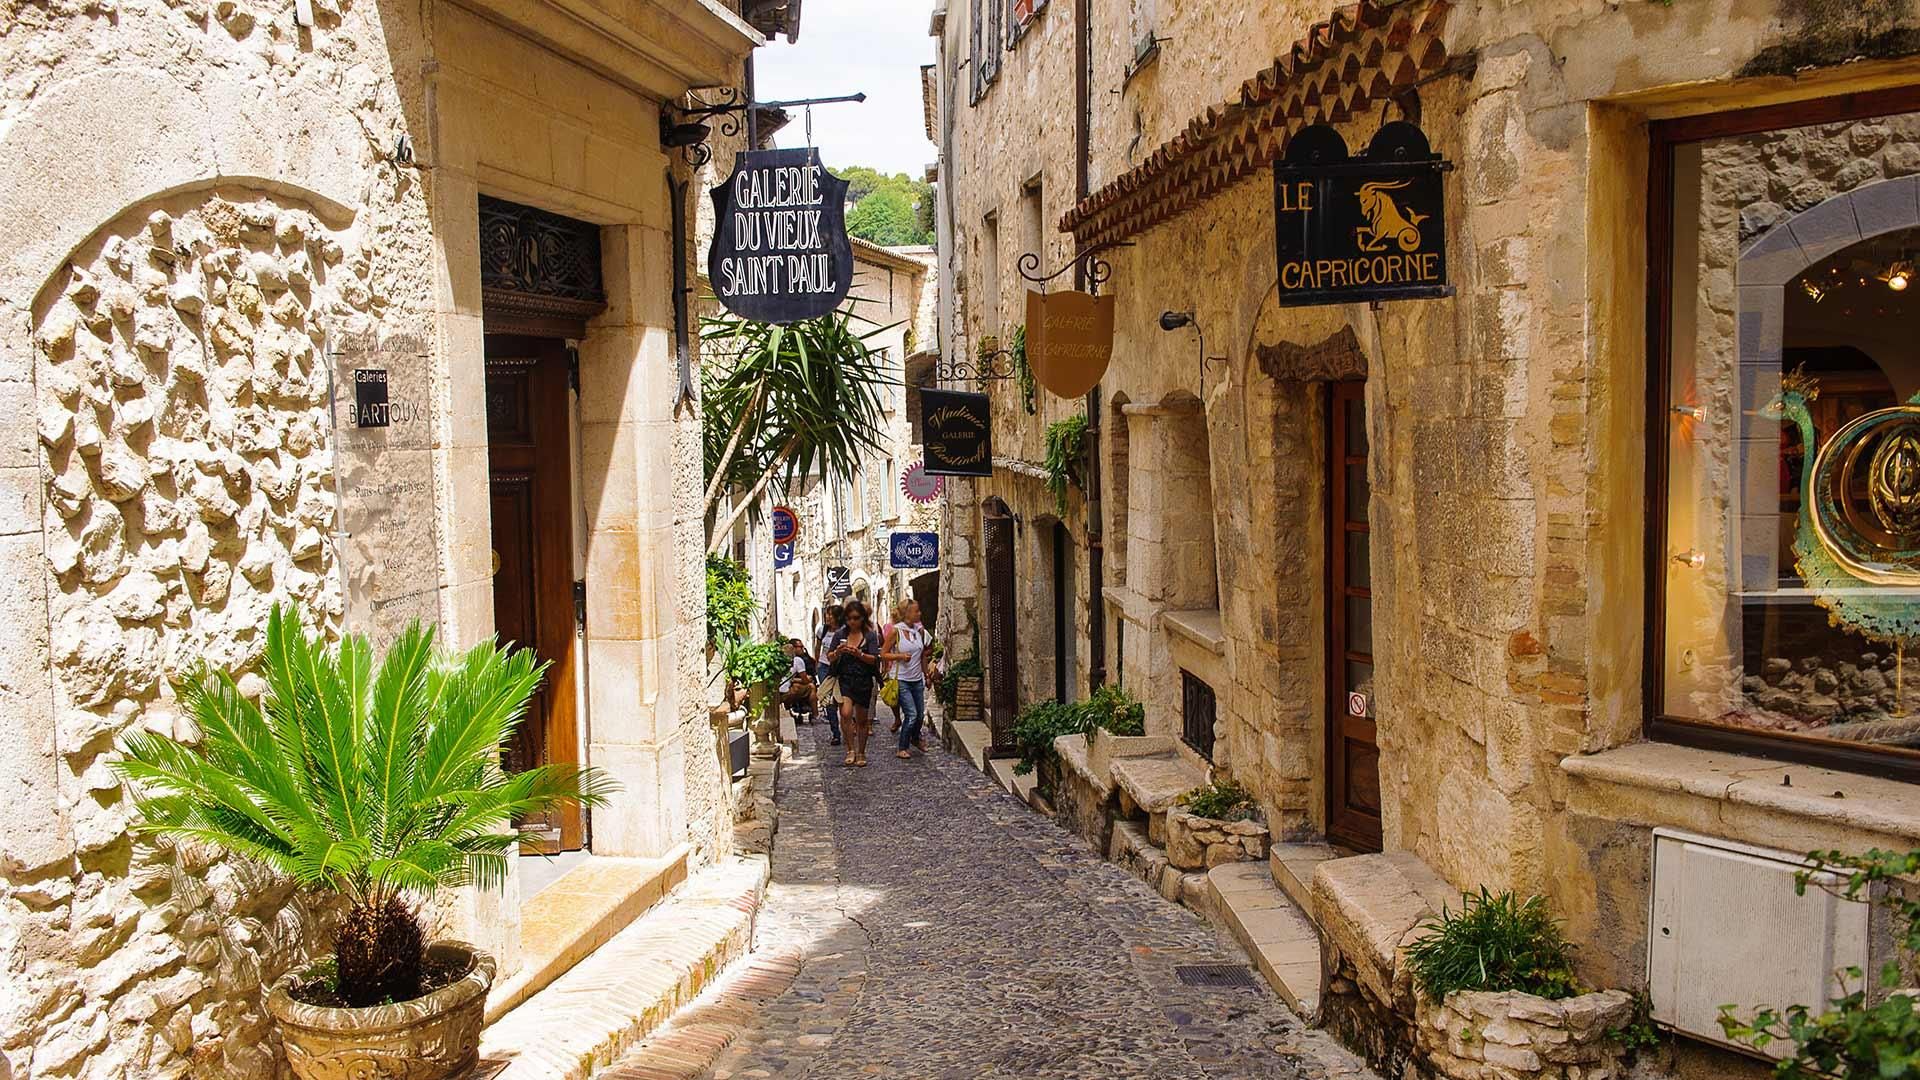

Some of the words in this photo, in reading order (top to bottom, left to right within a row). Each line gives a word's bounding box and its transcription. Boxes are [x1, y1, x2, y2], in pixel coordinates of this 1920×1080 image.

[735, 165, 823, 209] GALERIE
[1280, 182, 1314, 212] LE
[735, 212, 760, 251] DU
[763, 210, 822, 250] VIEUX
[721, 255, 784, 297] SAINT
[787, 254, 836, 293] PAUL
[1281, 252, 1439, 289] CAPRICORNE
[1042, 315, 1096, 330] GALERIE
[355, 370, 386, 383] Galeries
[349, 403, 421, 424] BARTOUX
[941, 431, 976, 440] GALERIE
[907, 547, 922, 555] MB
